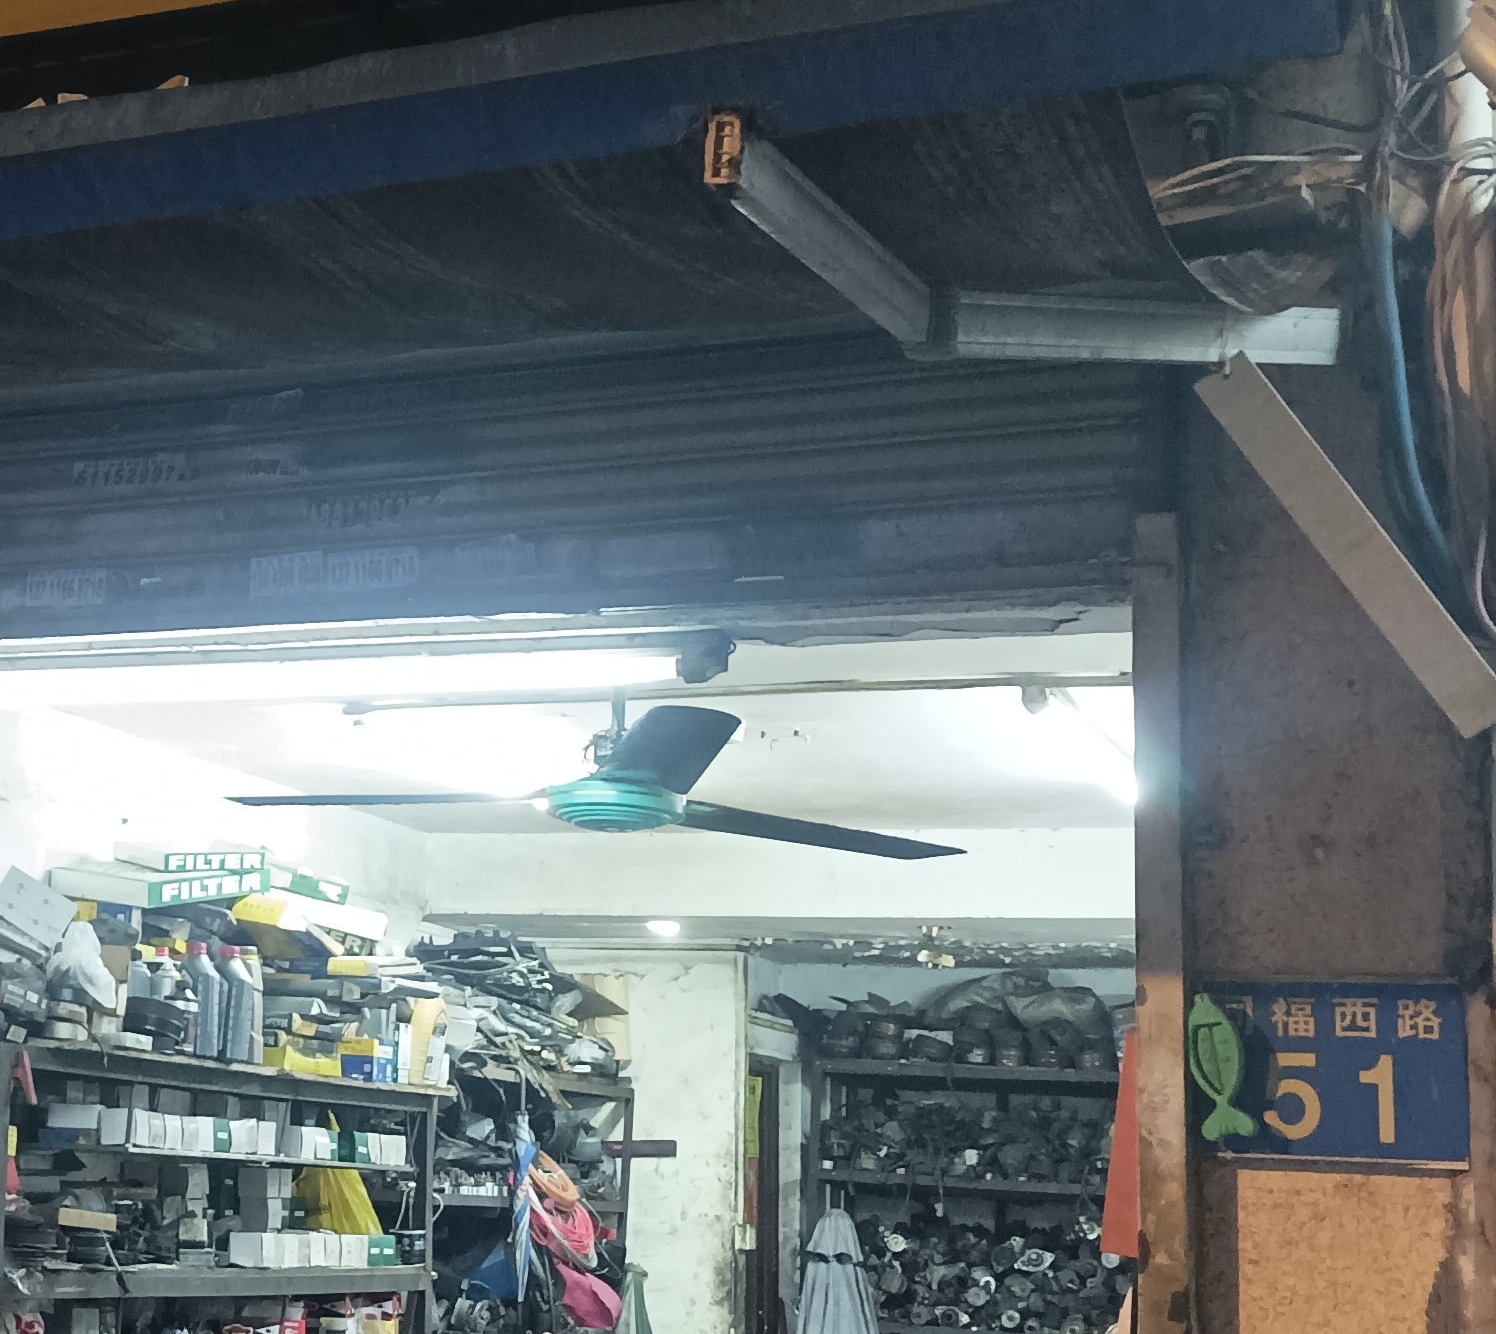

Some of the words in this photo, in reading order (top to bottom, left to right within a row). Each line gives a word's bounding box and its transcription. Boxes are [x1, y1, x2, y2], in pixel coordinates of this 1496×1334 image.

[168, 853, 263, 871] FILTER
[161, 873, 262, 903] FILTER
[1262, 1052, 1397, 1145] 51
